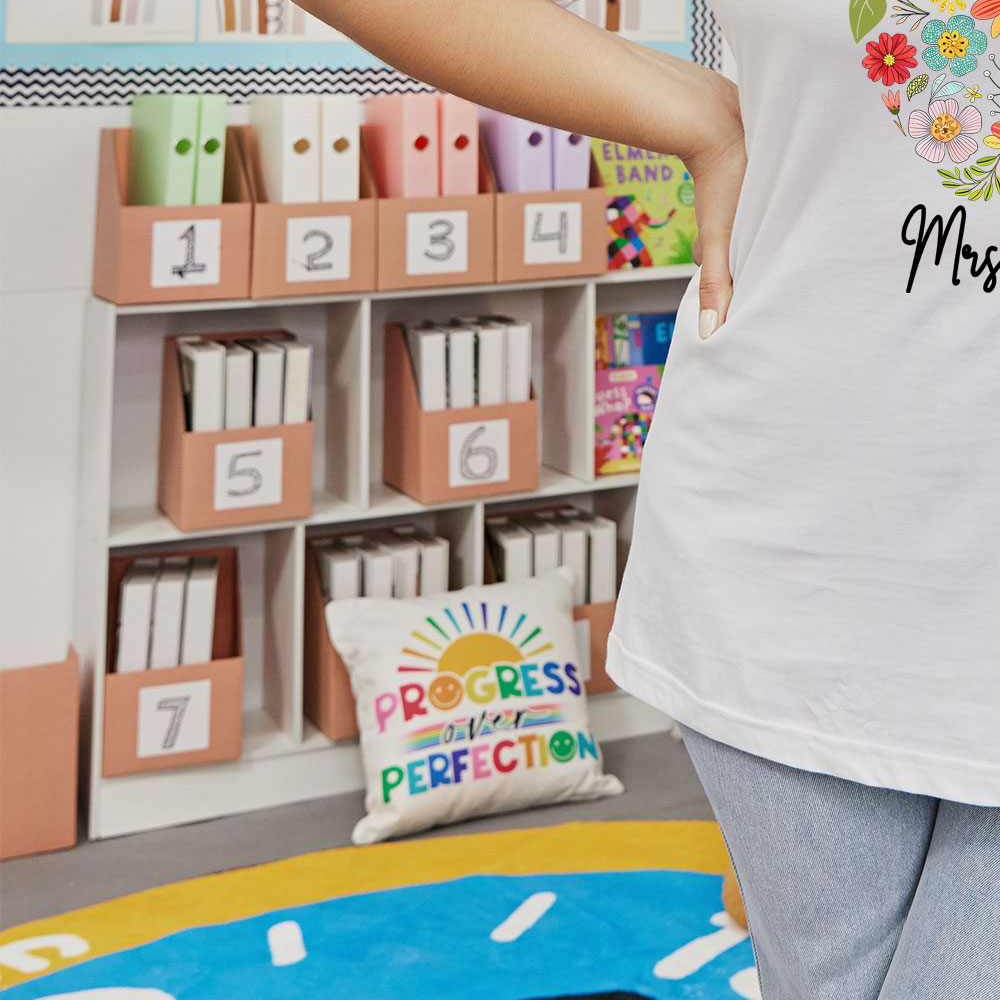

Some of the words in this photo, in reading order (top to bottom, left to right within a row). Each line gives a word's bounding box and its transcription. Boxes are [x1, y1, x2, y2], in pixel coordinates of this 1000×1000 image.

[616, 164, 673, 184] BAND
[171, 224, 207, 279] 1
[302, 229, 335, 272] 2
[424, 218, 457, 262] 3
[531, 210, 568, 255] 4
[226, 450, 263, 496] 5
[459, 425, 499, 481] 6
[375, 662, 581, 733] PROGRESS
[156, 695, 191, 750] 7
[443, 708, 530, 744] over
[381, 729, 599, 804] PERFECTION
